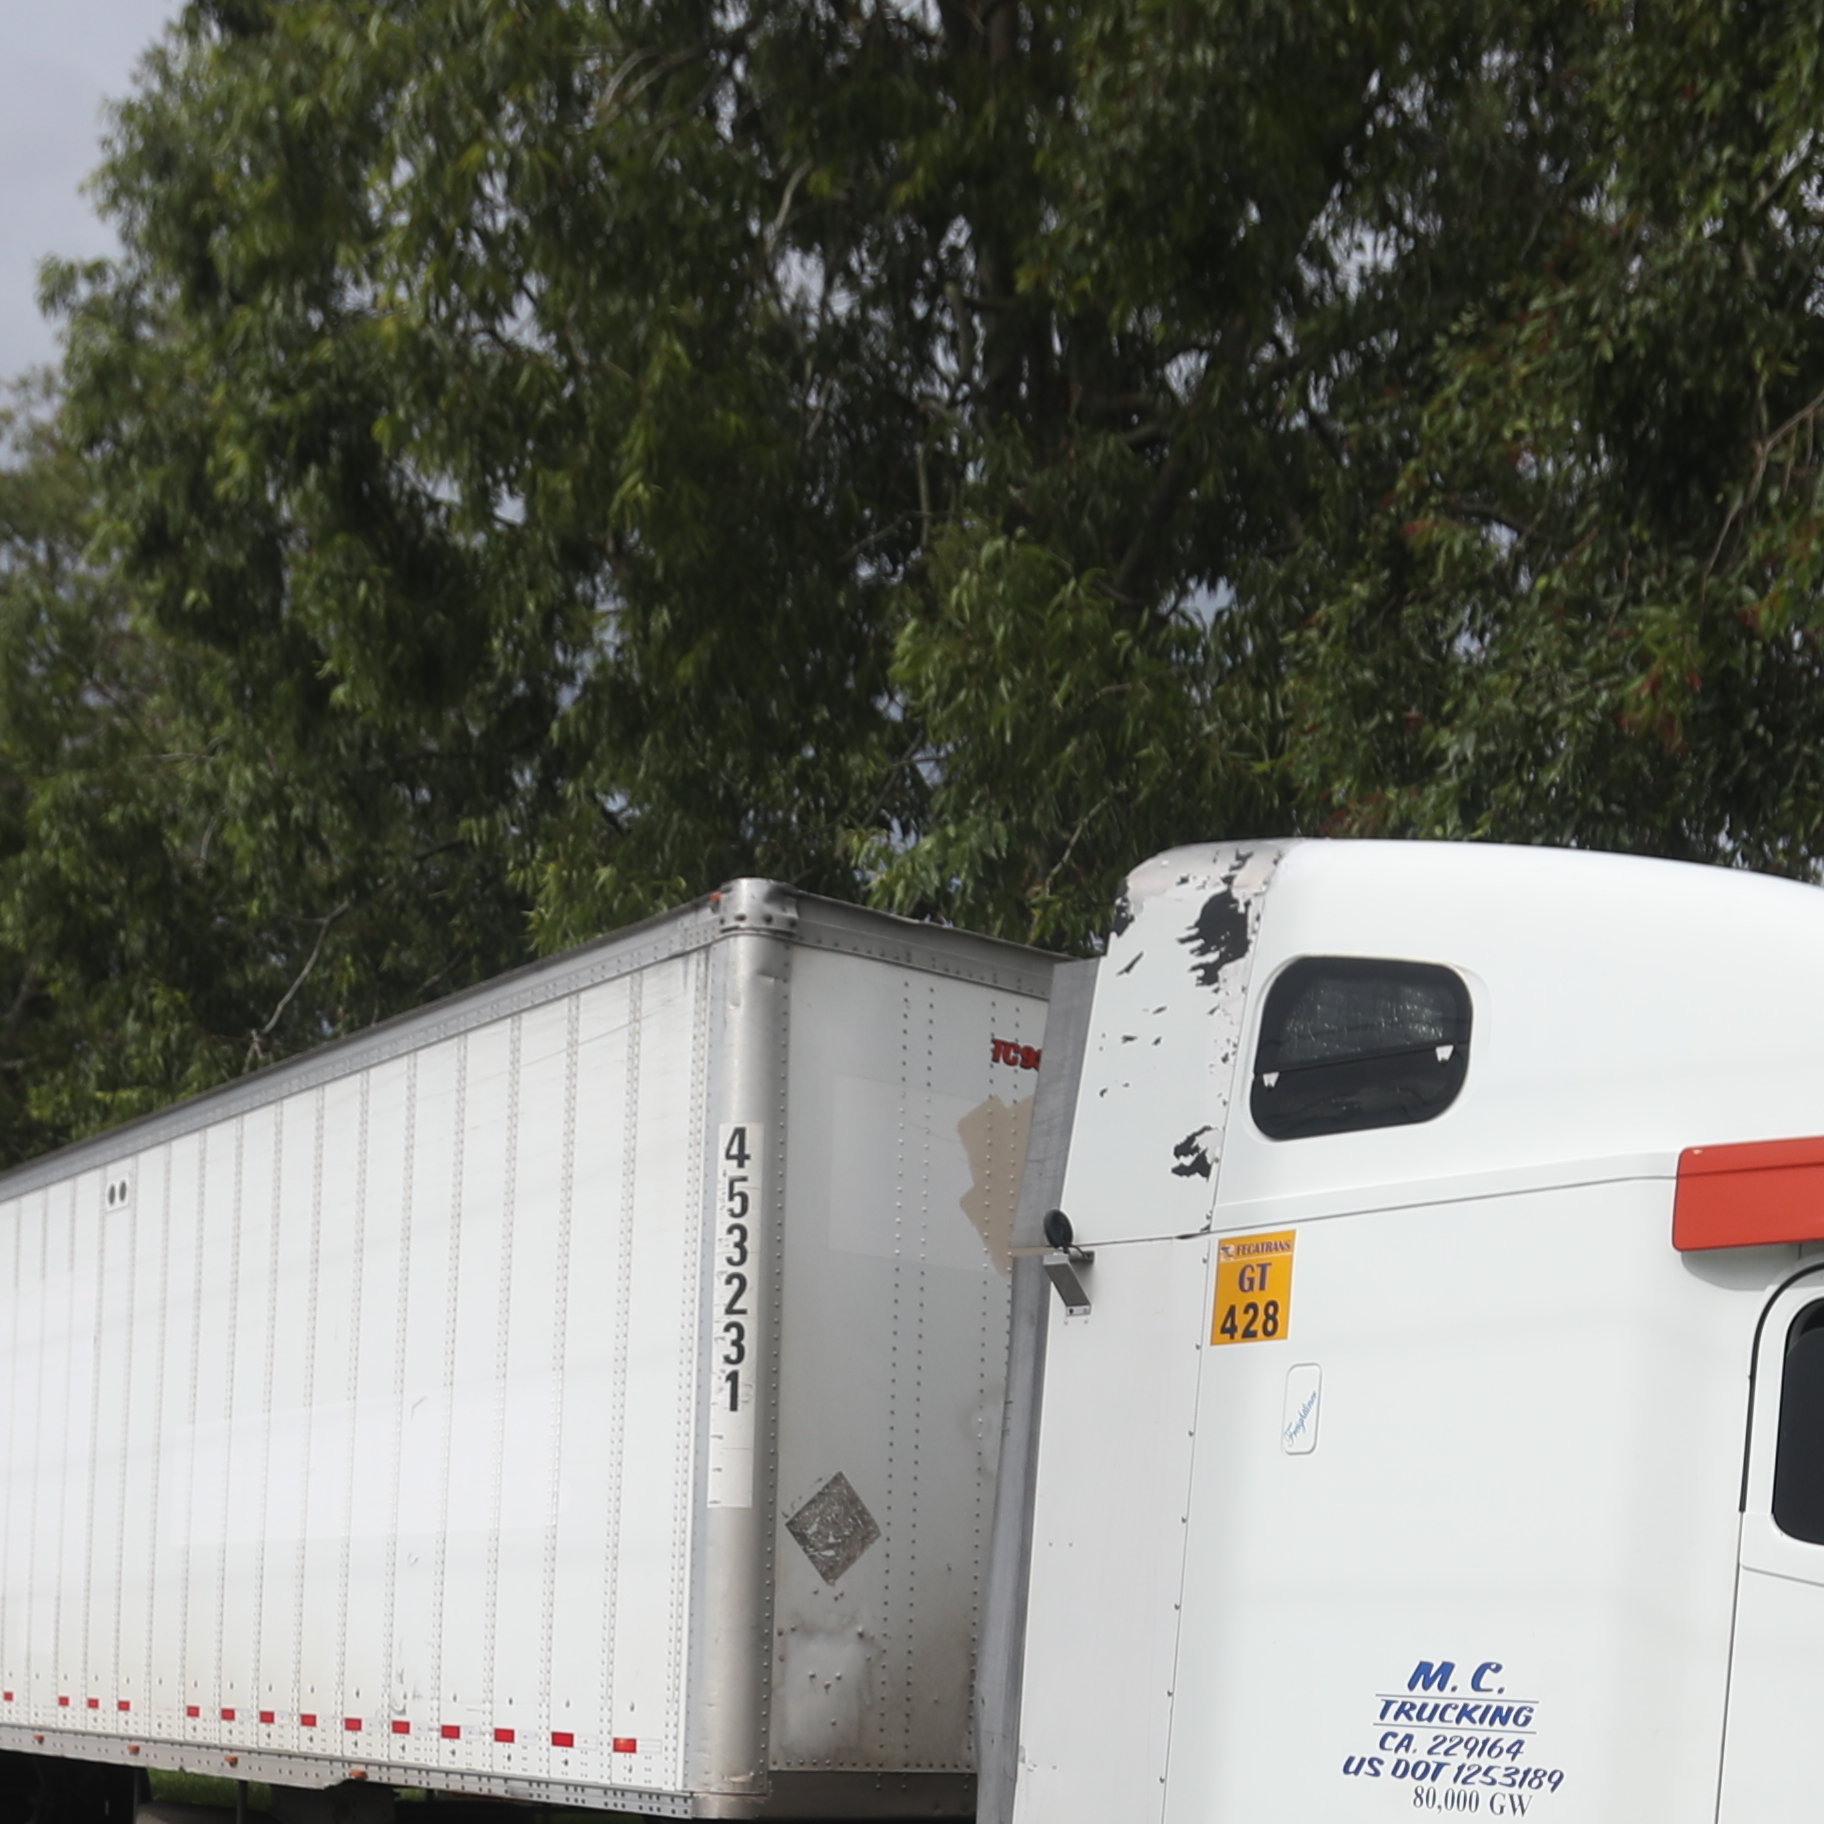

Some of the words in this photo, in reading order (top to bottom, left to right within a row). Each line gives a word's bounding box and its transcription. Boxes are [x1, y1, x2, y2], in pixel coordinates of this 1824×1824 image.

[990, 1038, 1043, 1071] TC9
[1236, 1240, 1291, 1256] FECATRANS
[724, 1127, 751, 1412] 453231
[1238, 1262, 1272, 1293] GT
[1220, 1300, 1279, 1340] 428
[1407, 1660, 1458, 1692] M.
[1471, 1661, 1505, 1695] C.
[1379, 1698, 1534, 1727] TRUCKING
[1379, 1731, 1417, 1754] CA.
[1427, 1734, 1525, 1762] 229164
[1342, 1755, 1385, 1778] US
[1391, 1757, 1451, 1783] DOT
[1453, 1762, 1564, 1793] 1253189
[1413, 1785, 1480, 1814] 80,000
[1489, 1791, 1533, 1817] GW
